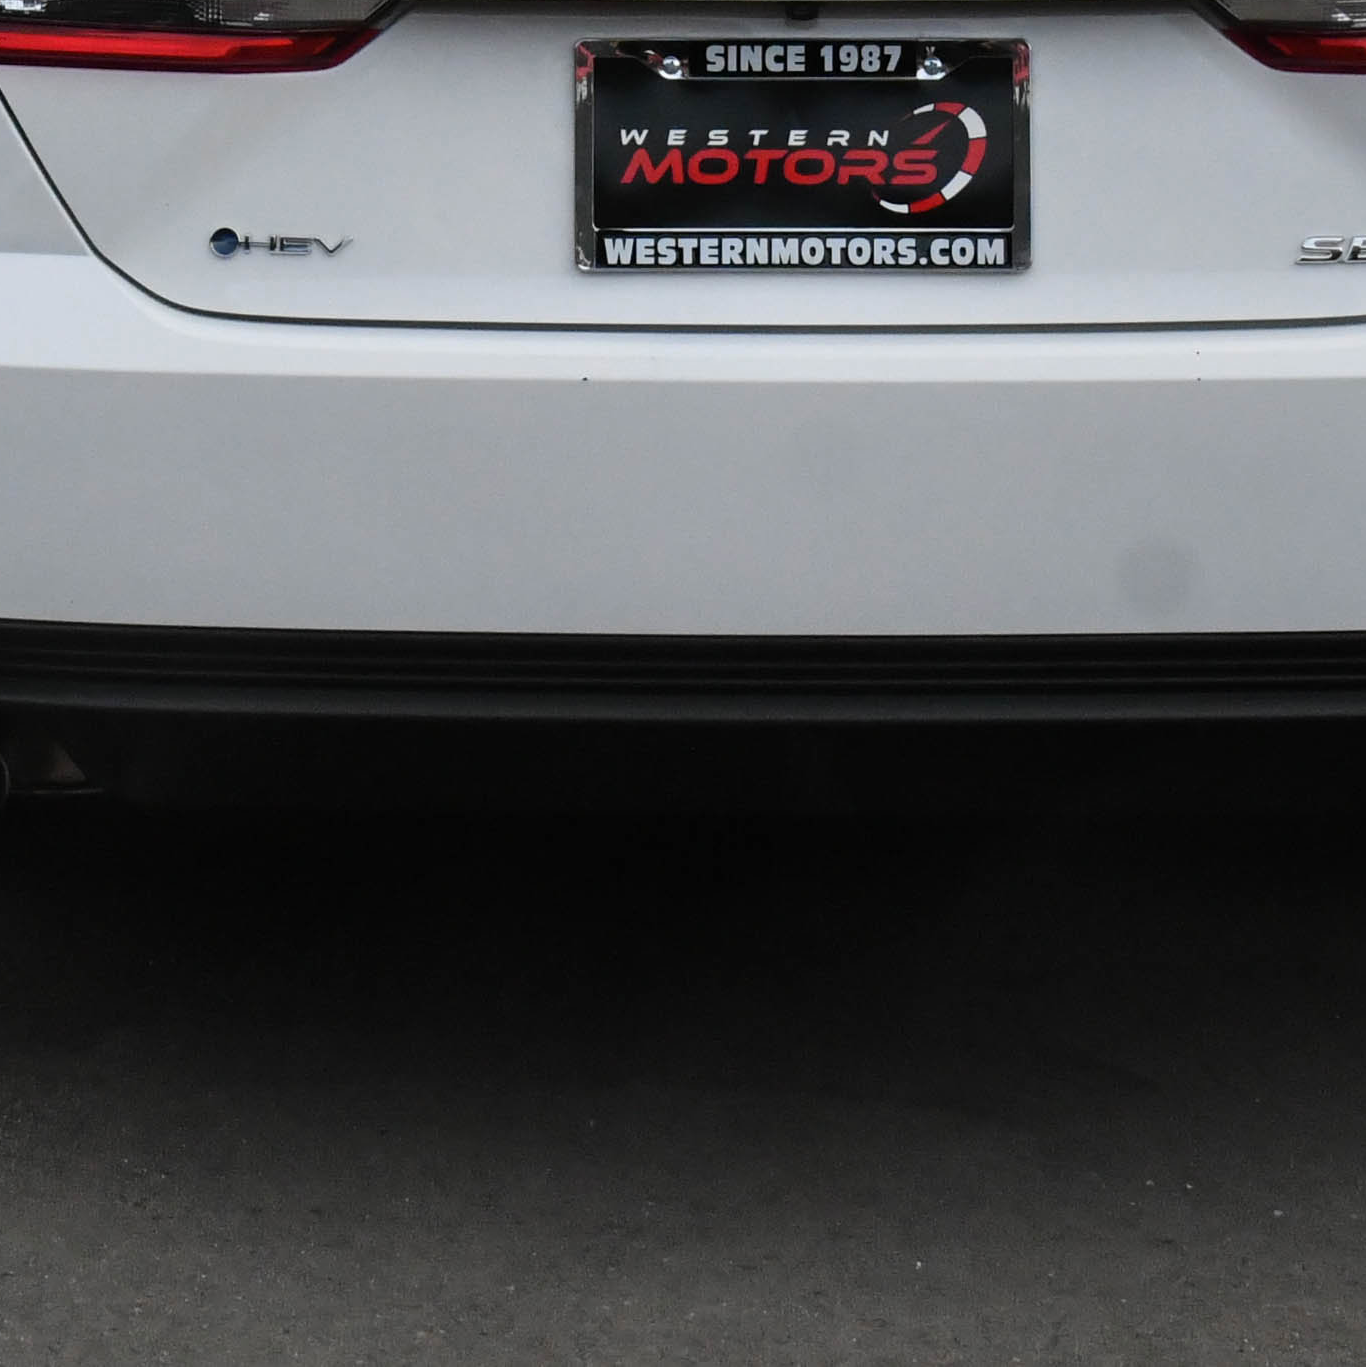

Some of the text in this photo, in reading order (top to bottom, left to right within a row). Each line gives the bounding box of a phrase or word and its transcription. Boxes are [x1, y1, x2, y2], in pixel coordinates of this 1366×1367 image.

[705, 45, 901, 72] SINCE 1987
[620, 129, 889, 146] WESTERN
[620, 149, 939, 186] MOTORS
[243, 234, 354, 256] HEV
[604, 238, 1005, 266] WESTERNMOTORS.COM
